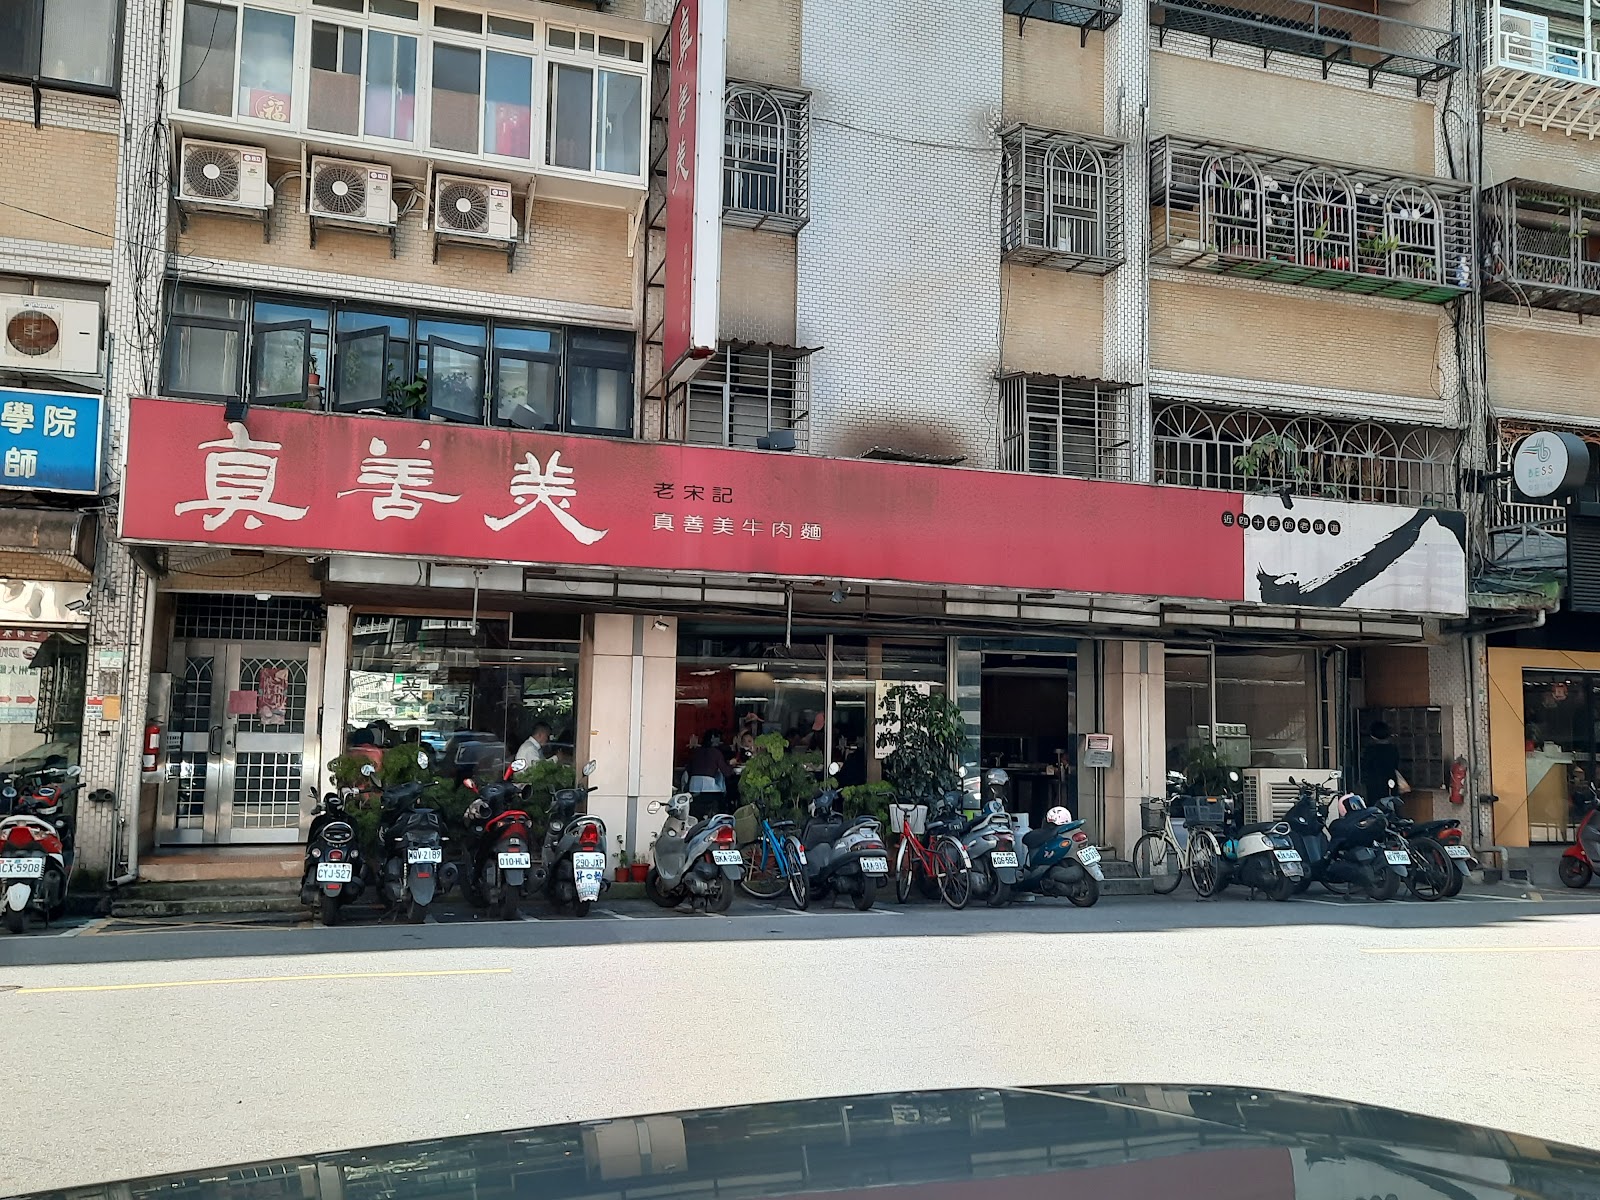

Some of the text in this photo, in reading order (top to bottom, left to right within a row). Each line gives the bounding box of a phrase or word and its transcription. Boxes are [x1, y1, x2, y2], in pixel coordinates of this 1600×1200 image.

[672, 6, 692, 195] 真善美
[1, 401, 77, 438] 學院
[4, 446, 38, 479] 師
[1528, 464, 1553, 478] BESS
[174, 422, 609, 546] 真善美
[653, 482, 733, 504] 老宋記
[652, 511, 823, 541] 真善美牛肉麵
[1223, 513, 1340, 534] 近四十年的老味道
[0, 863, 40, 873] CX-5908
[317, 869, 351, 879] CYJ-527
